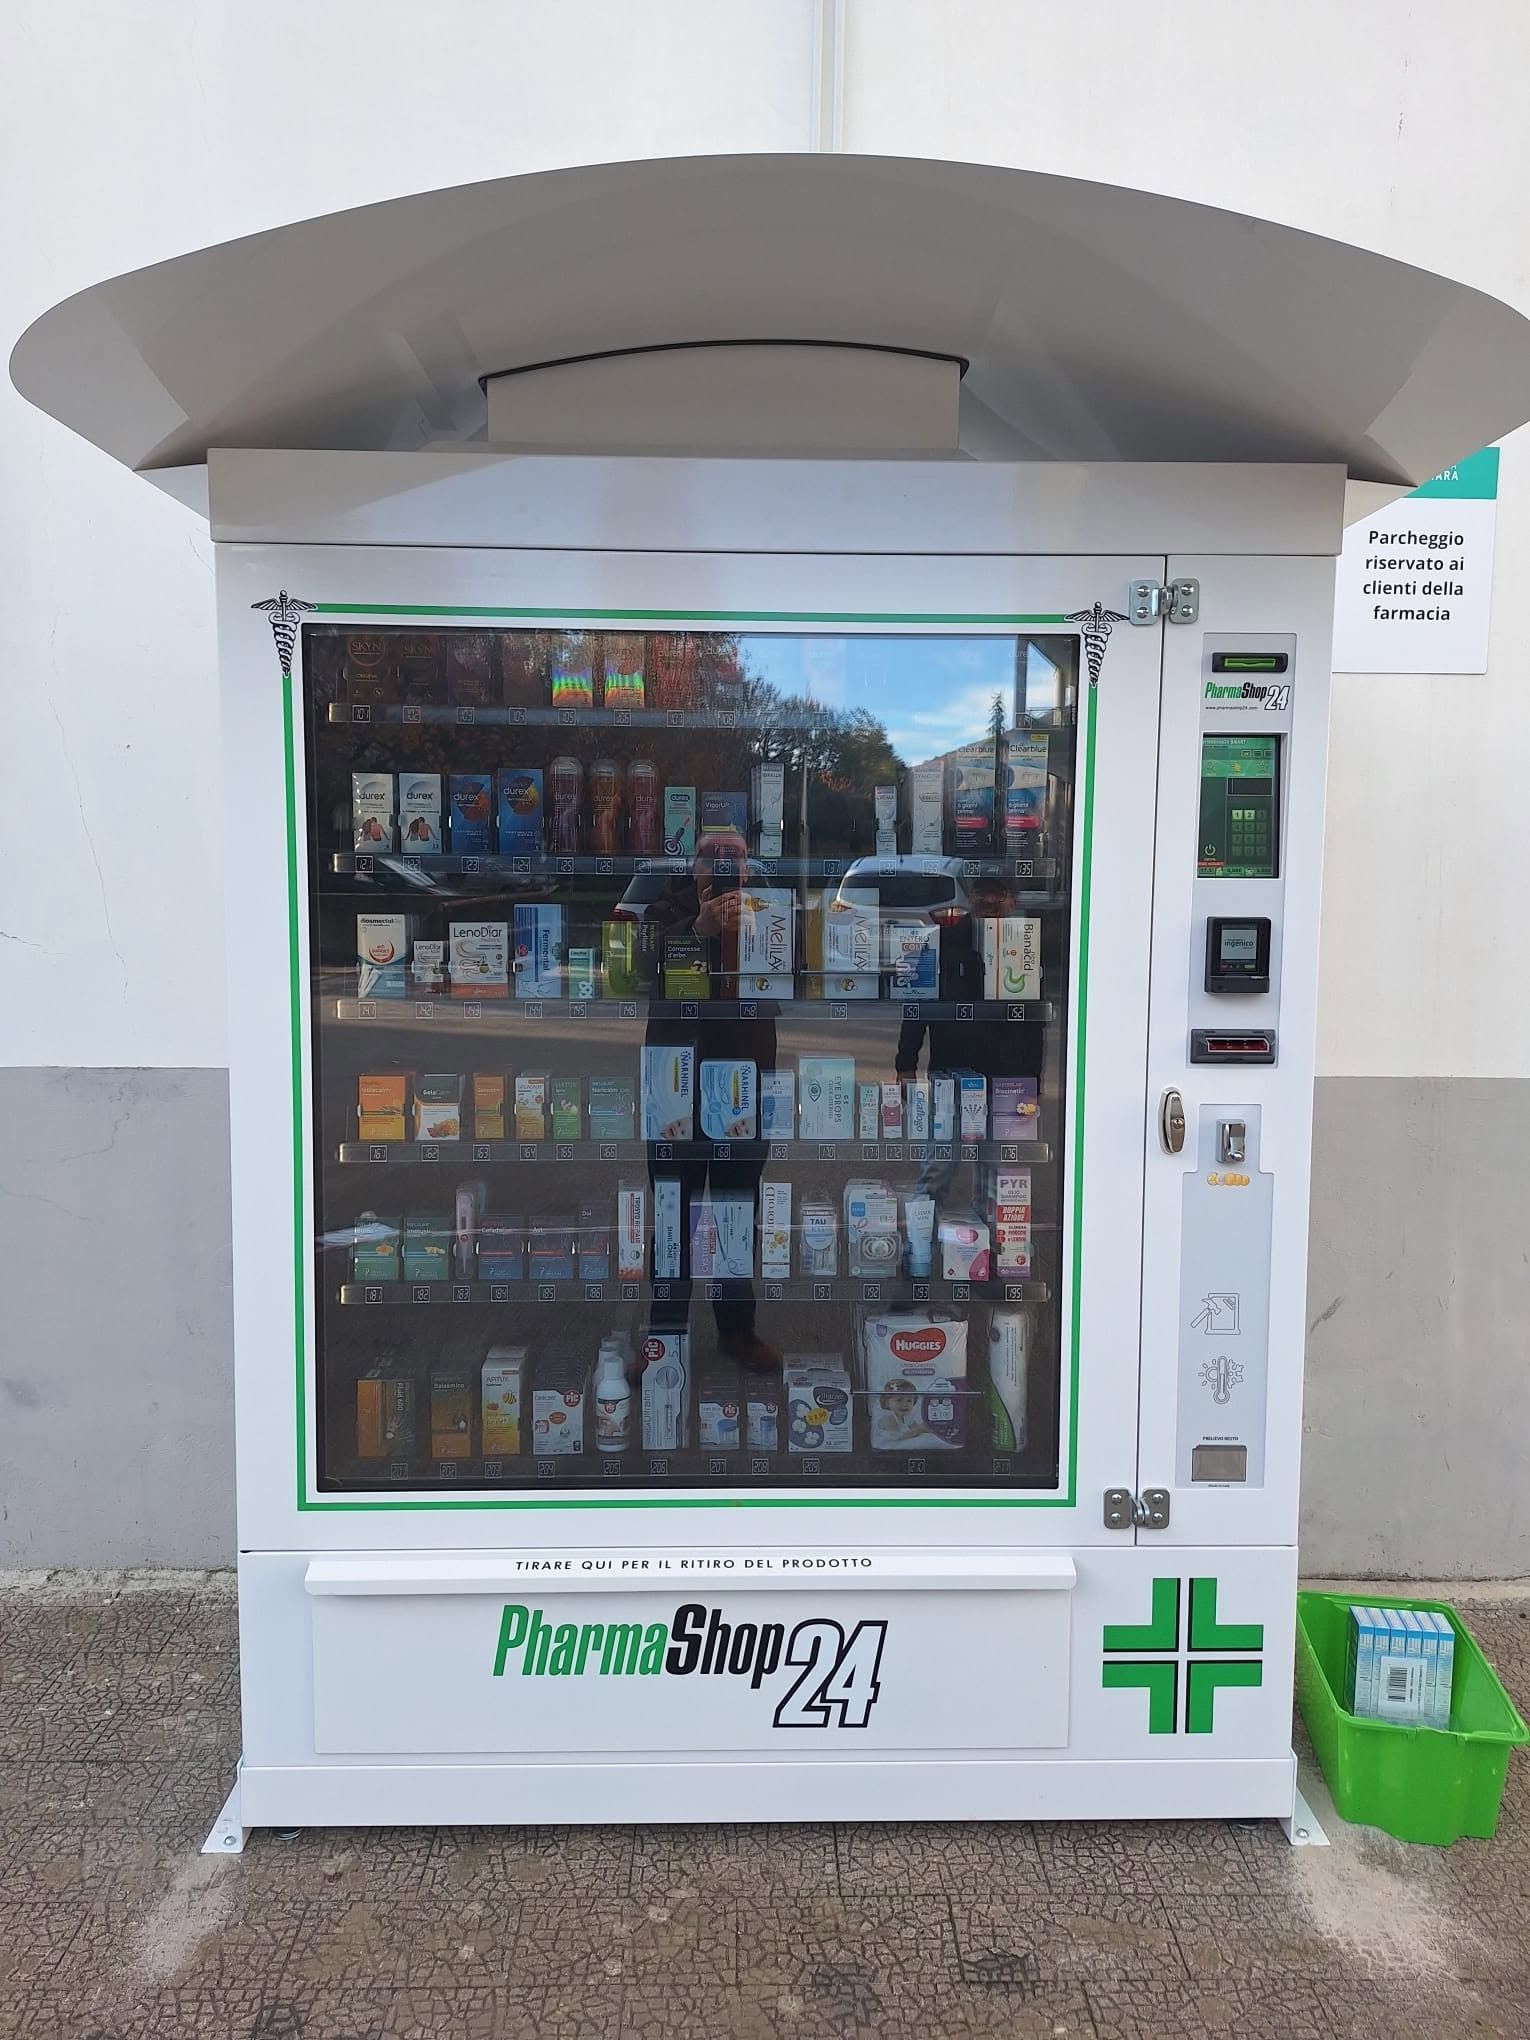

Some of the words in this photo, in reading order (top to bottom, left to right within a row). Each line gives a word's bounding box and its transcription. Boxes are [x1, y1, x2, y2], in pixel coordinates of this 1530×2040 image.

[1432, 470, 1458, 480] ARA
[1369, 530, 1464, 550] Parcheggio
[1366, 556, 1444, 570] riservato
[1450, 556, 1464, 571] ai
[1363, 580, 1416, 596] clienti
[1422, 581, 1463, 596] della
[1374, 606, 1450, 620] farmacia
[352, 640, 381, 651] SKYN
[958, 745, 994, 753] Clearblue
[1010, 744, 1047, 753] Clearblue
[360, 792, 385, 800] durex
[407, 792, 433, 800] durex
[454, 793, 480, 801] durex
[504, 787, 529, 796] durex
[360, 858, 372, 870] 121
[466, 858, 478, 871] 123
[516, 858, 530, 872] 124
[560, 860, 572, 872] 125
[600, 860, 612, 872] 126
[1018, 862, 1032, 874] 135
[453, 928, 502, 938] LenoDiar
[1024, 924, 1033, 970] Bianacid
[1224, 940, 1254, 950] ingenico
[906, 1005, 918, 1017] 150
[960, 1005, 972, 1017] 151
[1011, 1006, 1023, 1018] 152
[680, 1055, 689, 1098] NARHINEL
[741, 1067, 750, 1111] NARHINEL
[1000, 1179, 1028, 1188] PYR
[370, 1288, 382, 1301] 181
[418, 1288, 429, 1300] 182
[626, 1287, 638, 1298] 187
[866, 1286, 879, 1298] 192
[916, 1286, 928, 1298] 193
[956, 1286, 968, 1299] 194
[1008, 1287, 1022, 1299] 195
[896, 1339, 941, 1351] HUGGIES
[566, 1392, 579, 1402] PiC
[725, 1404, 736, 1414] PiC
[604, 1463, 618, 1474] 205
[712, 1462, 726, 1474] 207
[516, 1560, 572, 1570] TIRARE
[582, 1560, 612, 1570] QUI
[622, 1560, 649, 1570] PER
[658, 1560, 672, 1569] IL
[681, 1559, 735, 1569] RITIRO
[744, 1559, 774, 1568] DEL
[782, 1558, 872, 1568] PRODOTTO
